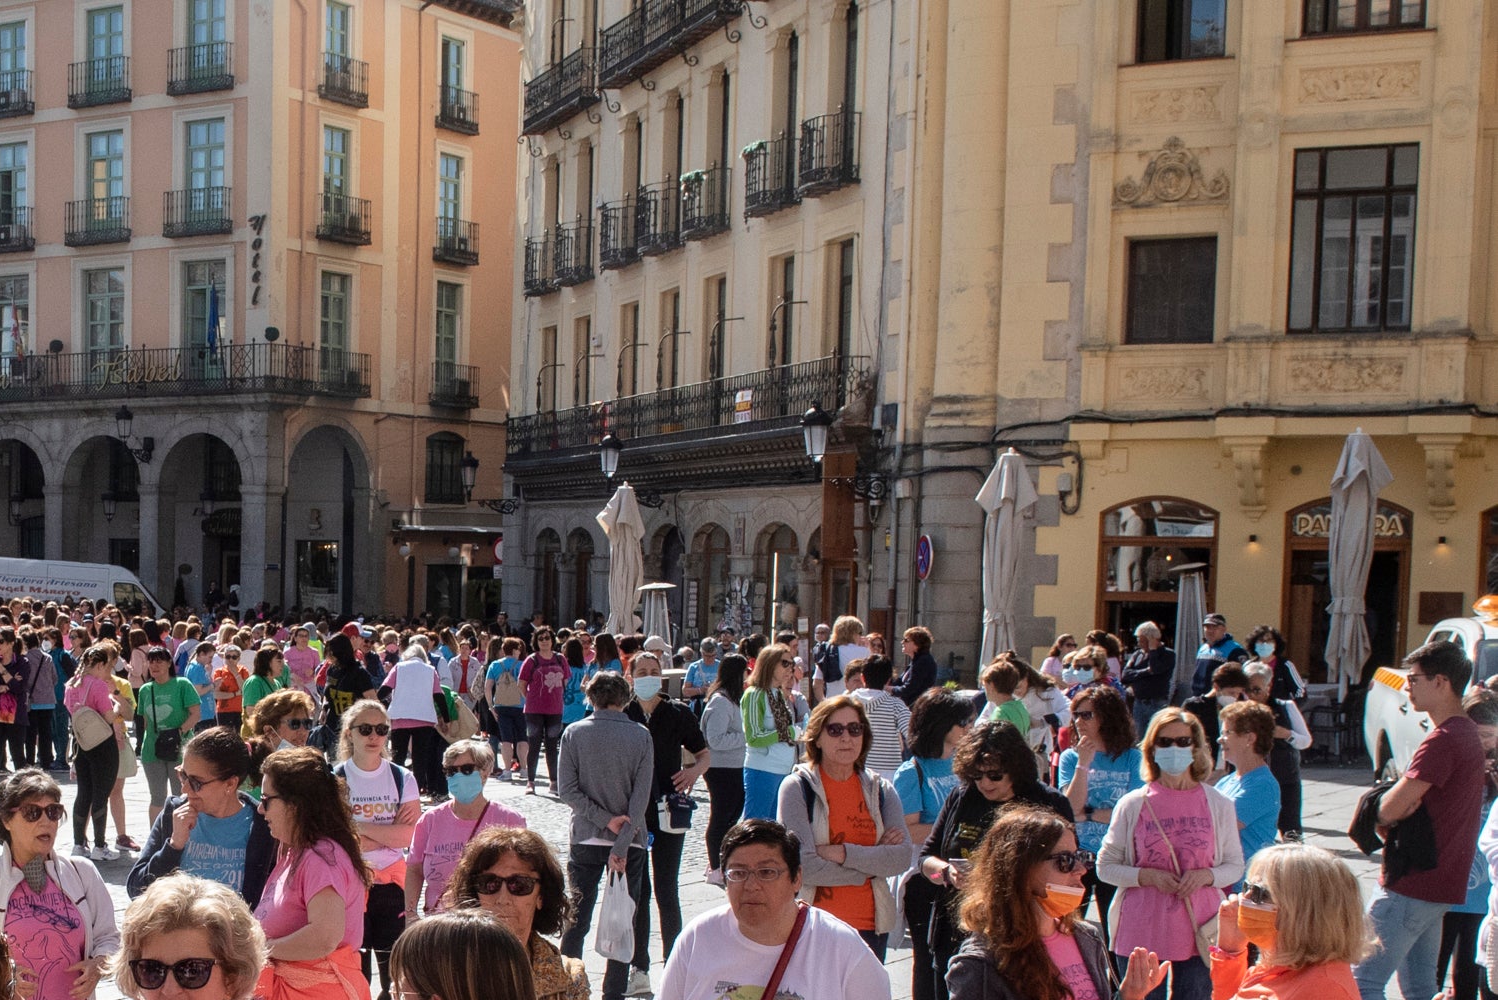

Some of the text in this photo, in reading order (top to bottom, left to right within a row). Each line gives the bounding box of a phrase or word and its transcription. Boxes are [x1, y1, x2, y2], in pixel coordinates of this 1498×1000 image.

[247, 214, 266, 305] Hotel
[92, 353, 183, 391] Isabel
[352, 799, 398, 818] egovi
